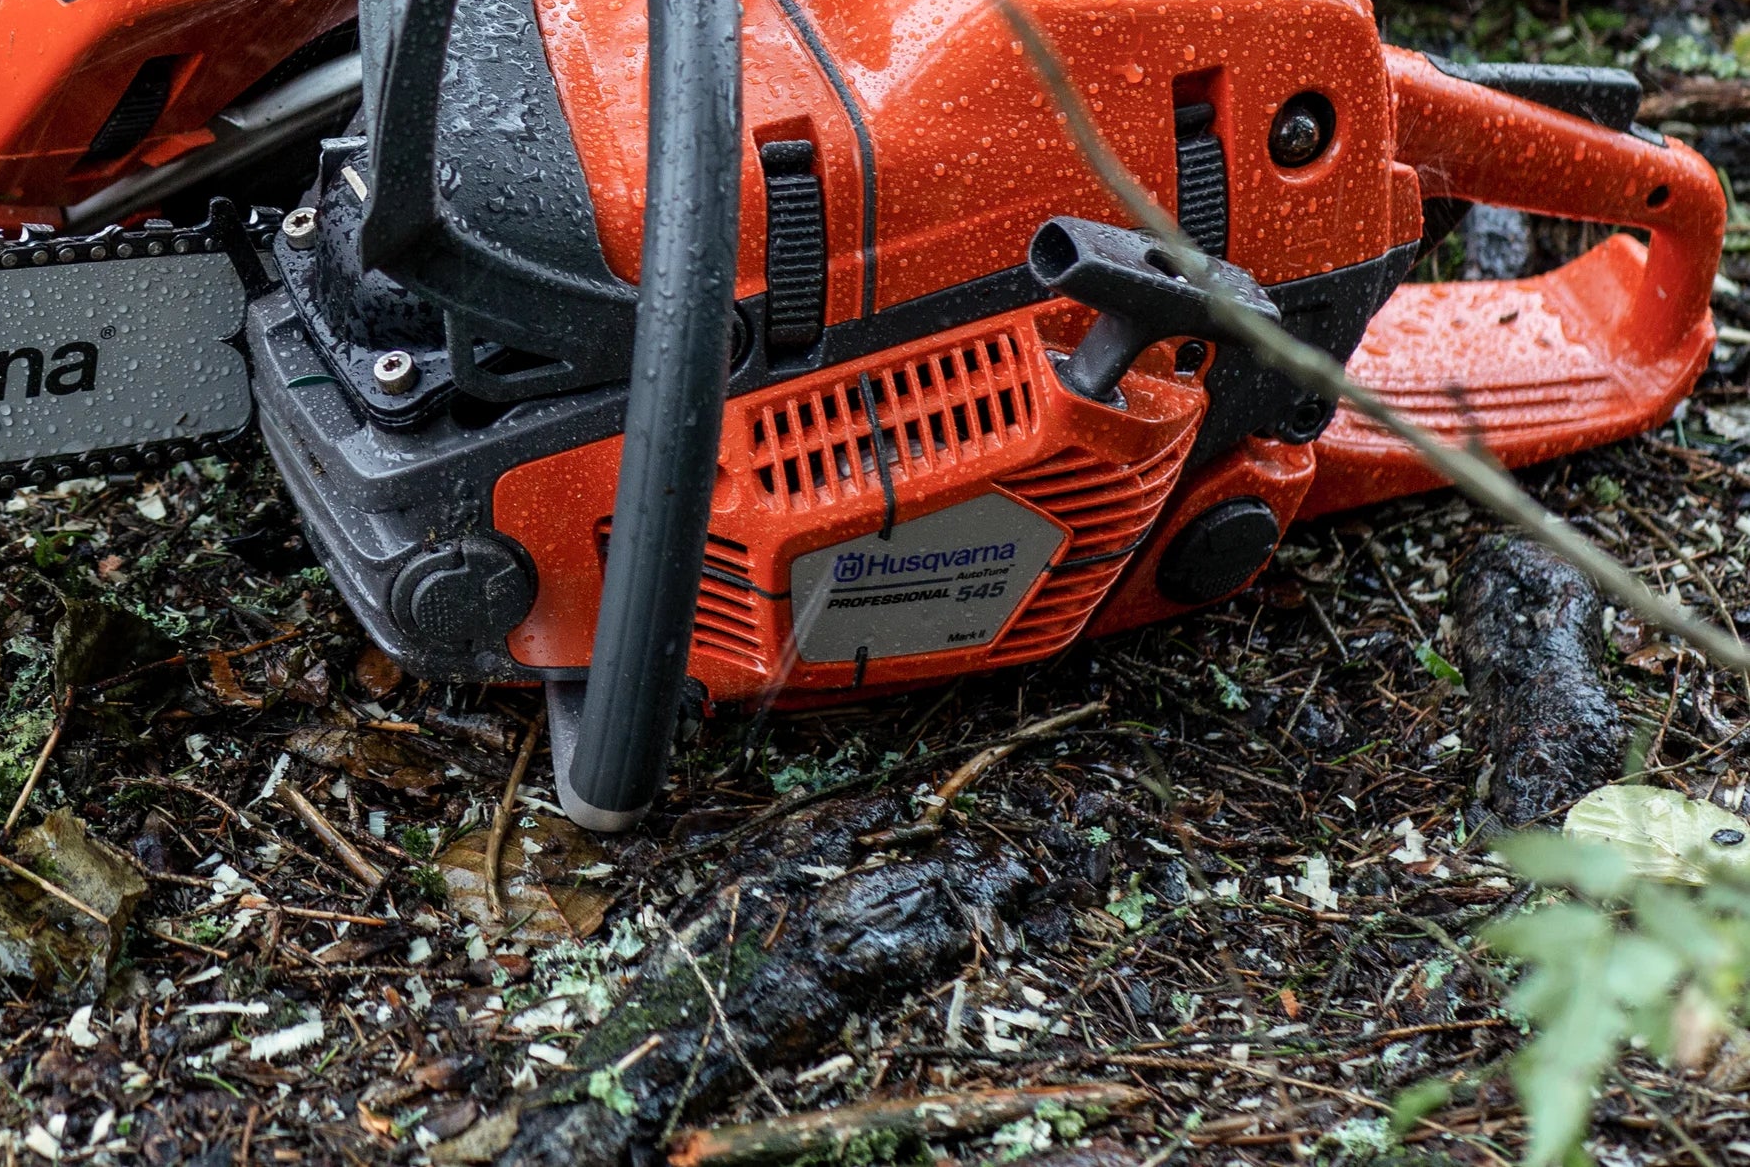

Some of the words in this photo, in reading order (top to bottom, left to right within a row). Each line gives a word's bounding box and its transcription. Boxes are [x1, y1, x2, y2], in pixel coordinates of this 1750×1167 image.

[866, 542, 1017, 576] Husqvarna
[827, 588, 950, 609] PROFESSIONAL
[955, 581, 1008, 602] 545
[947, 631, 976, 643] Mark
